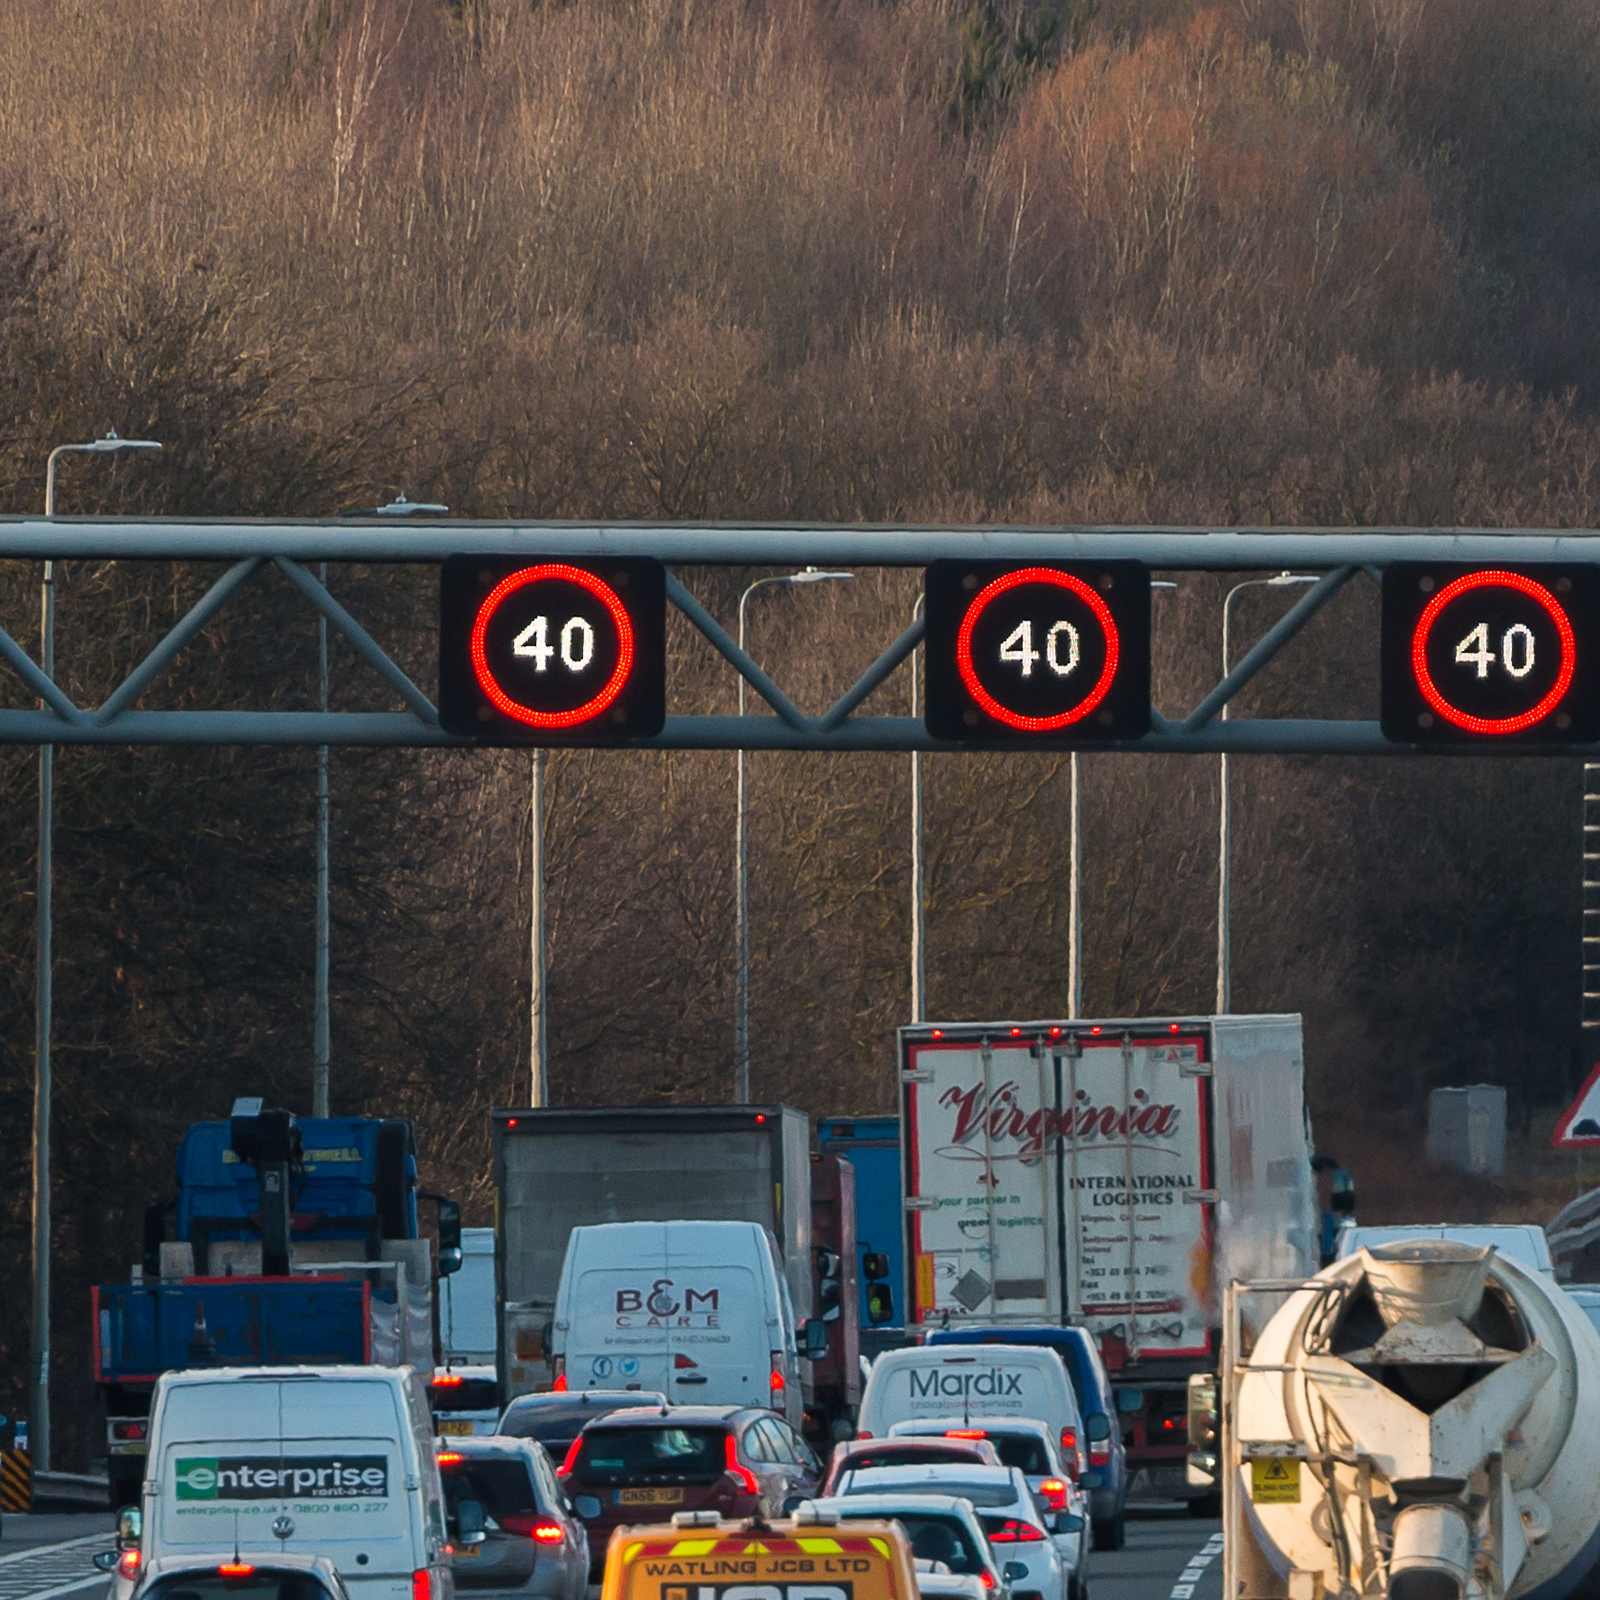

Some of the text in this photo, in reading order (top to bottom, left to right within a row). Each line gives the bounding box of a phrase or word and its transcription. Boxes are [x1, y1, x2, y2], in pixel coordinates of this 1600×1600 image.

[512, 614, 594, 673] 40
[999, 620, 1081, 677] 40
[1453, 622, 1536, 680] 40
[938, 1080, 1182, 1166] Virginia
[1069, 1174, 1196, 1189] INTERNATIONAL
[1092, 1191, 1174, 1207] LOGISTICS
[616, 1315, 719, 1327] CARE
[910, 1366, 1022, 1398] Mardix
[187, 1462, 385, 1494] enterprise
[311, 1486, 385, 1497] rent-a-car
[644, 1558, 871, 1577] WATLING JCB LTD
